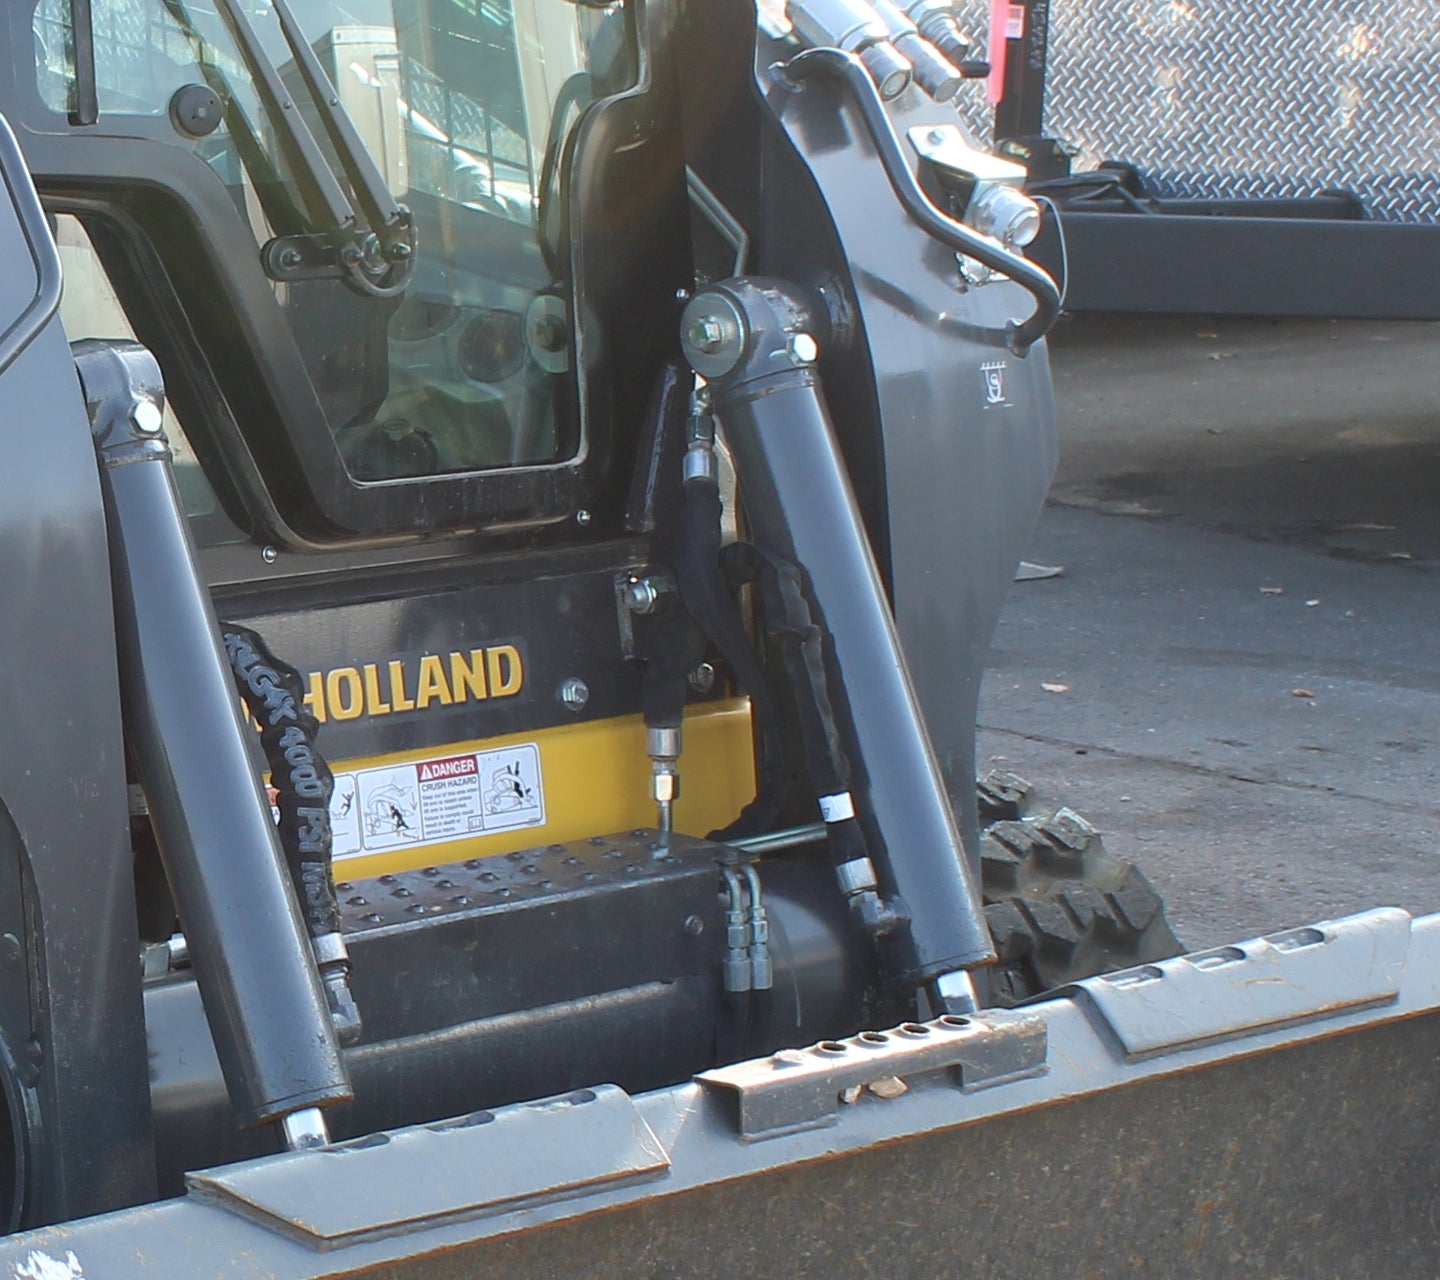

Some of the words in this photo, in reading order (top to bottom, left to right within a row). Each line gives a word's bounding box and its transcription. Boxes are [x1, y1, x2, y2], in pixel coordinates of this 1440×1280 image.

[303, 645, 523, 723] HOLLAND
[279, 726, 325, 798] 4000
[421, 780, 446, 792] CRUSH
[448, 776, 477, 788] HAZARD
[432, 759, 476, 778] DANGER
[297, 807, 329, 853] PSI
